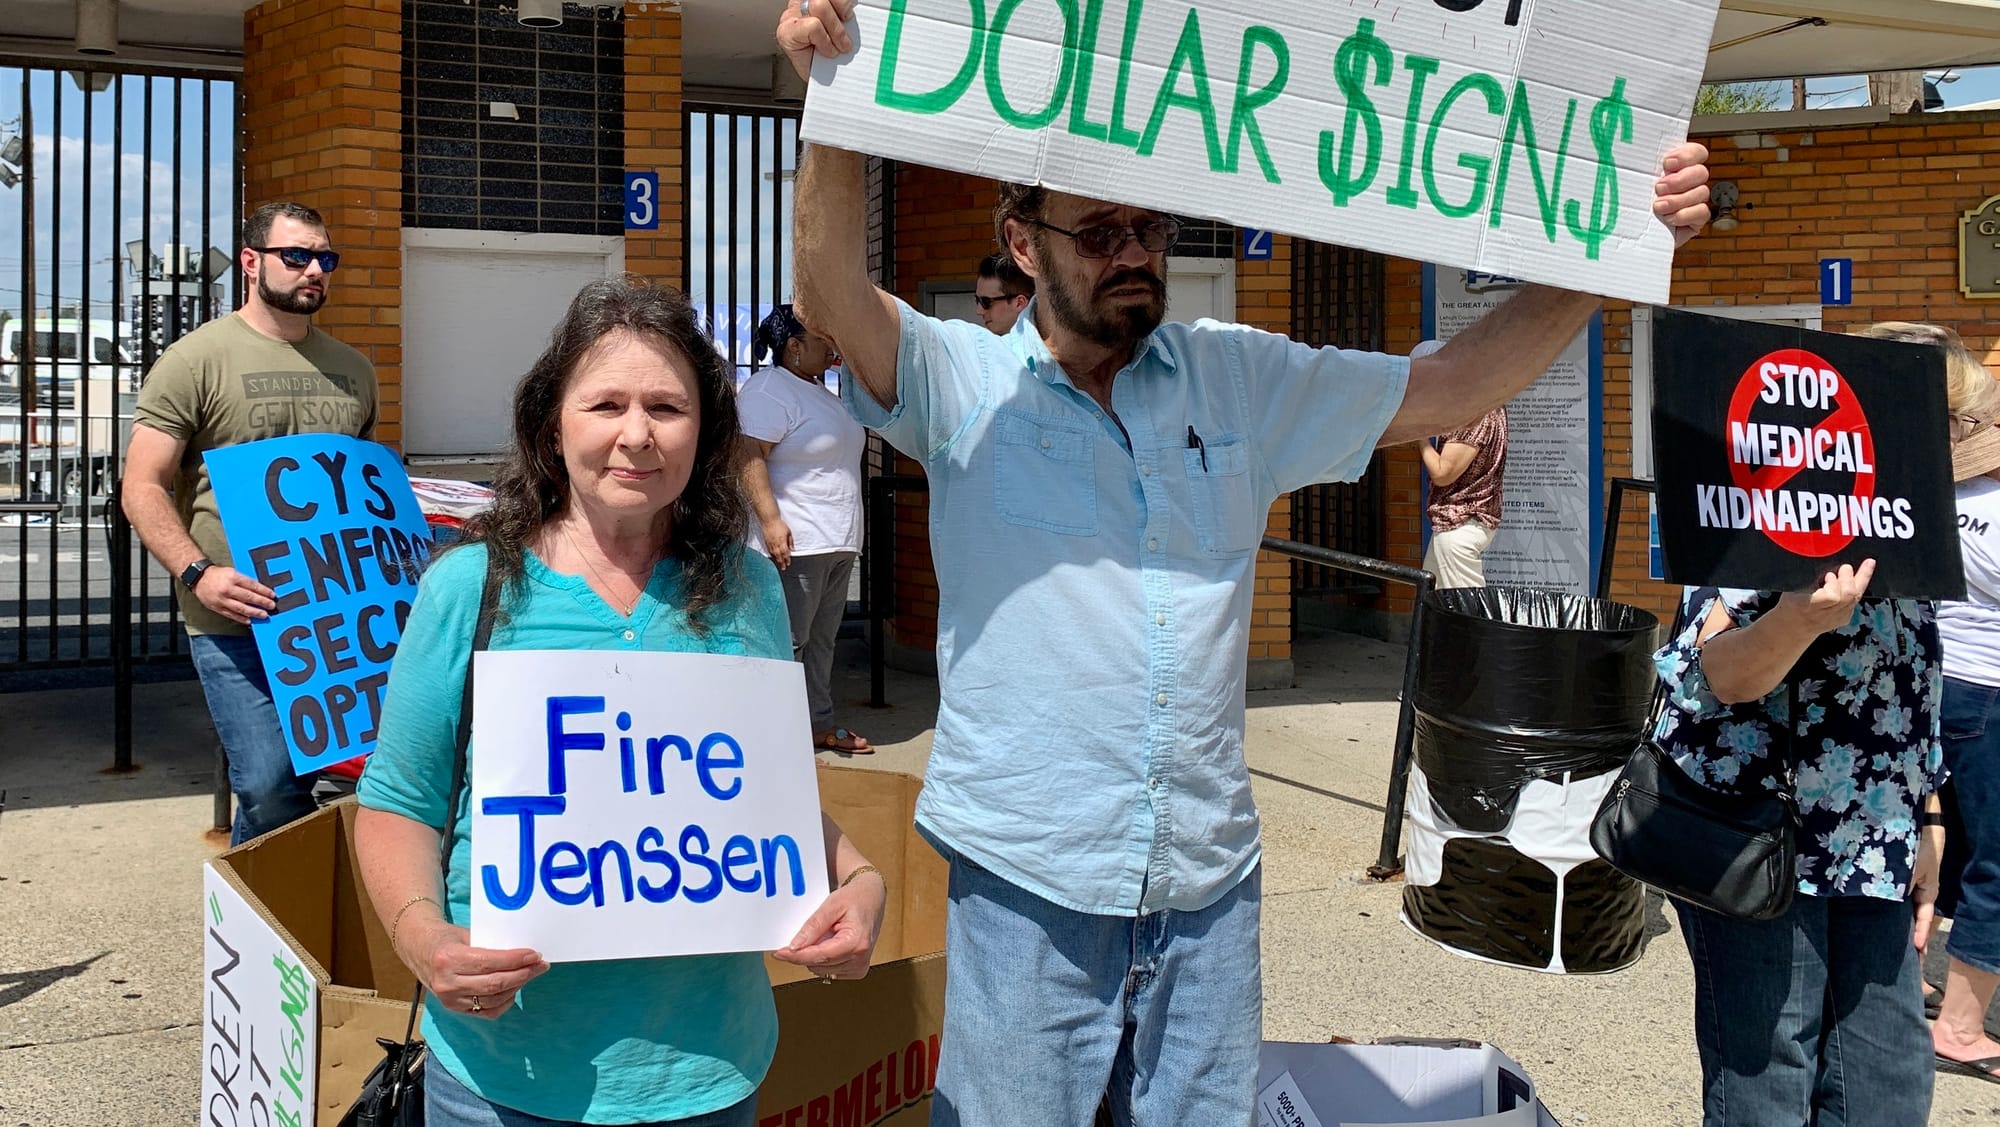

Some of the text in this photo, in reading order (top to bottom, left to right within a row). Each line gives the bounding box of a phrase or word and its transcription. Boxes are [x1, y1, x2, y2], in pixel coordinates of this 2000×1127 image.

[874, 0, 1634, 261] DOLLAR $IGN$
[630, 177, 653, 225] 3
[1828, 260, 1842, 300] 1
[247, 376, 321, 393] STANDBY
[1759, 361, 1840, 411] STOP
[248, 400, 361, 429] GET SOME
[1731, 421, 1873, 474] MEDICAL
[264, 451, 396, 522] CYS
[1696, 483, 1916, 540] KIDNAPPINGS
[289, 671, 388, 757] OPI
[546, 695, 745, 801] Fire
[482, 795, 806, 911] Jenssen
